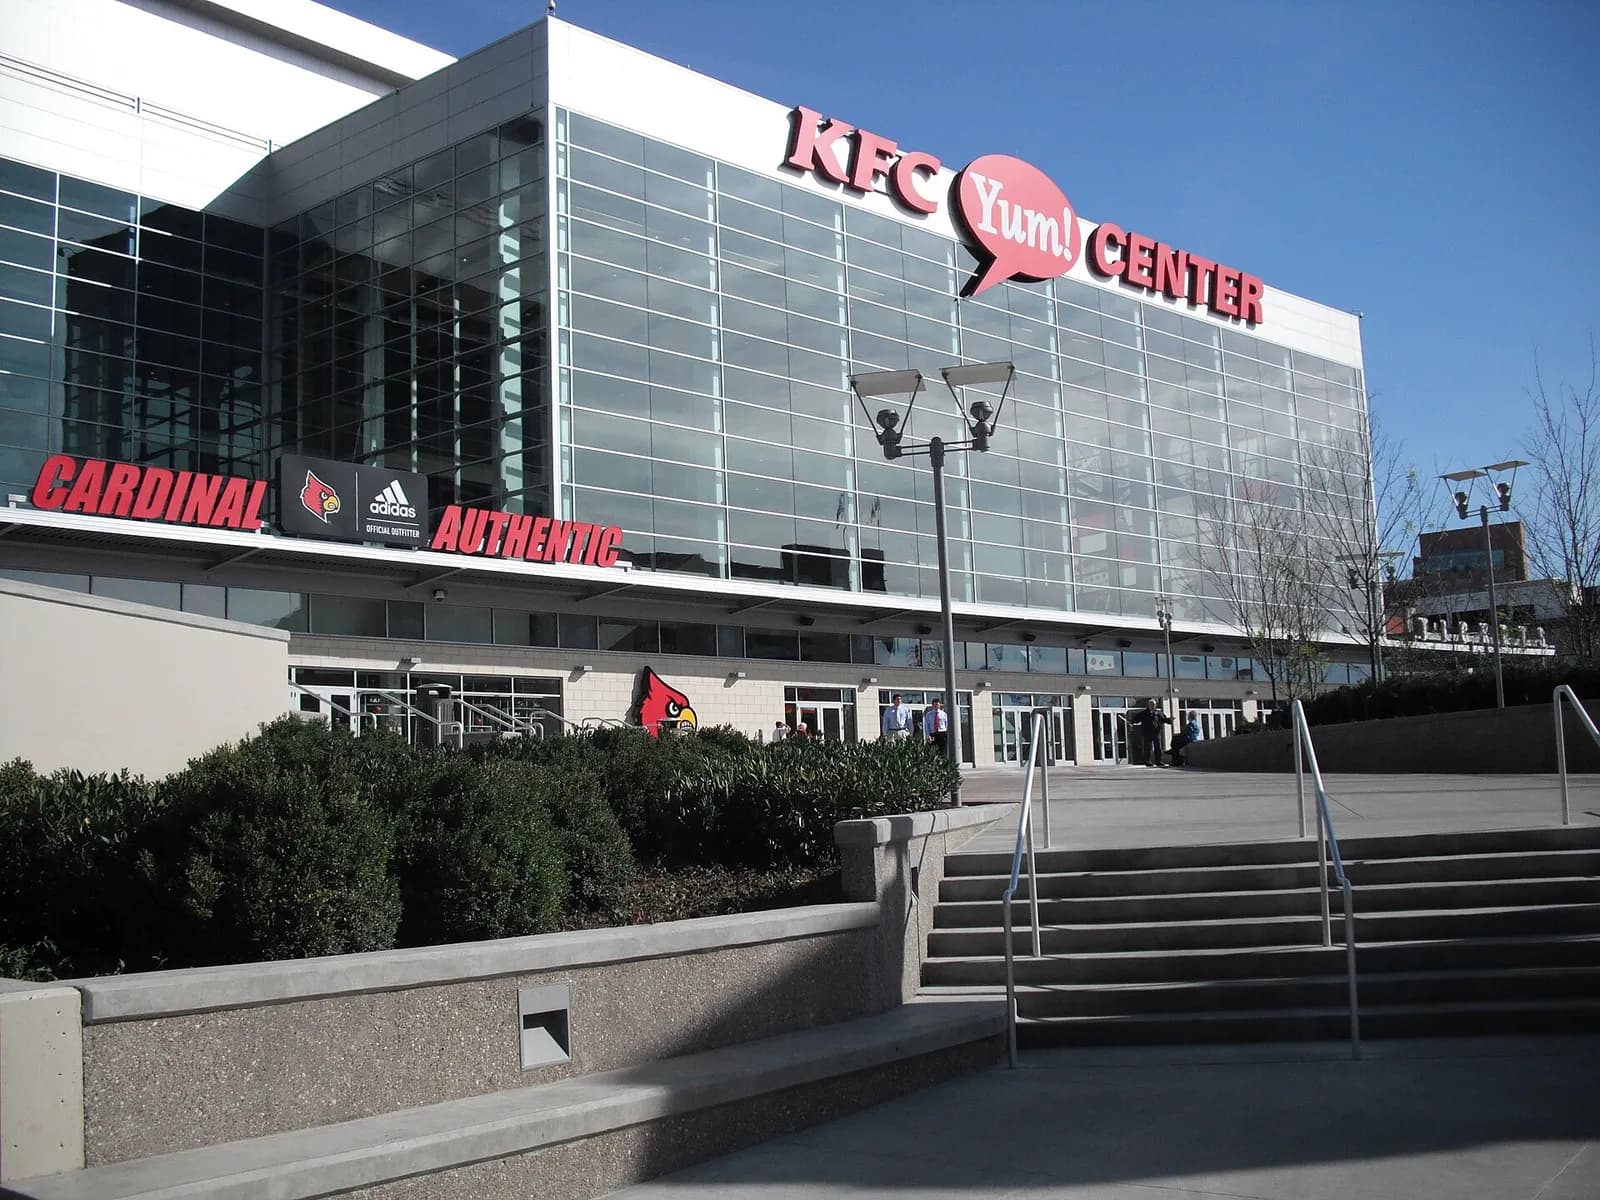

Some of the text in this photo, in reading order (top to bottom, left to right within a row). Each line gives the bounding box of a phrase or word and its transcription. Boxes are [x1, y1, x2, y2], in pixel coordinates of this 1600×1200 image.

[789, 105, 1264, 325] KFC Yum! CENTER
[32, 454, 268, 530] CARDINAL
[369, 501, 416, 518] adidas
[366, 524, 420, 538] OFFICIAL OUTFITTER
[431, 504, 623, 568] AUTHENTIC
